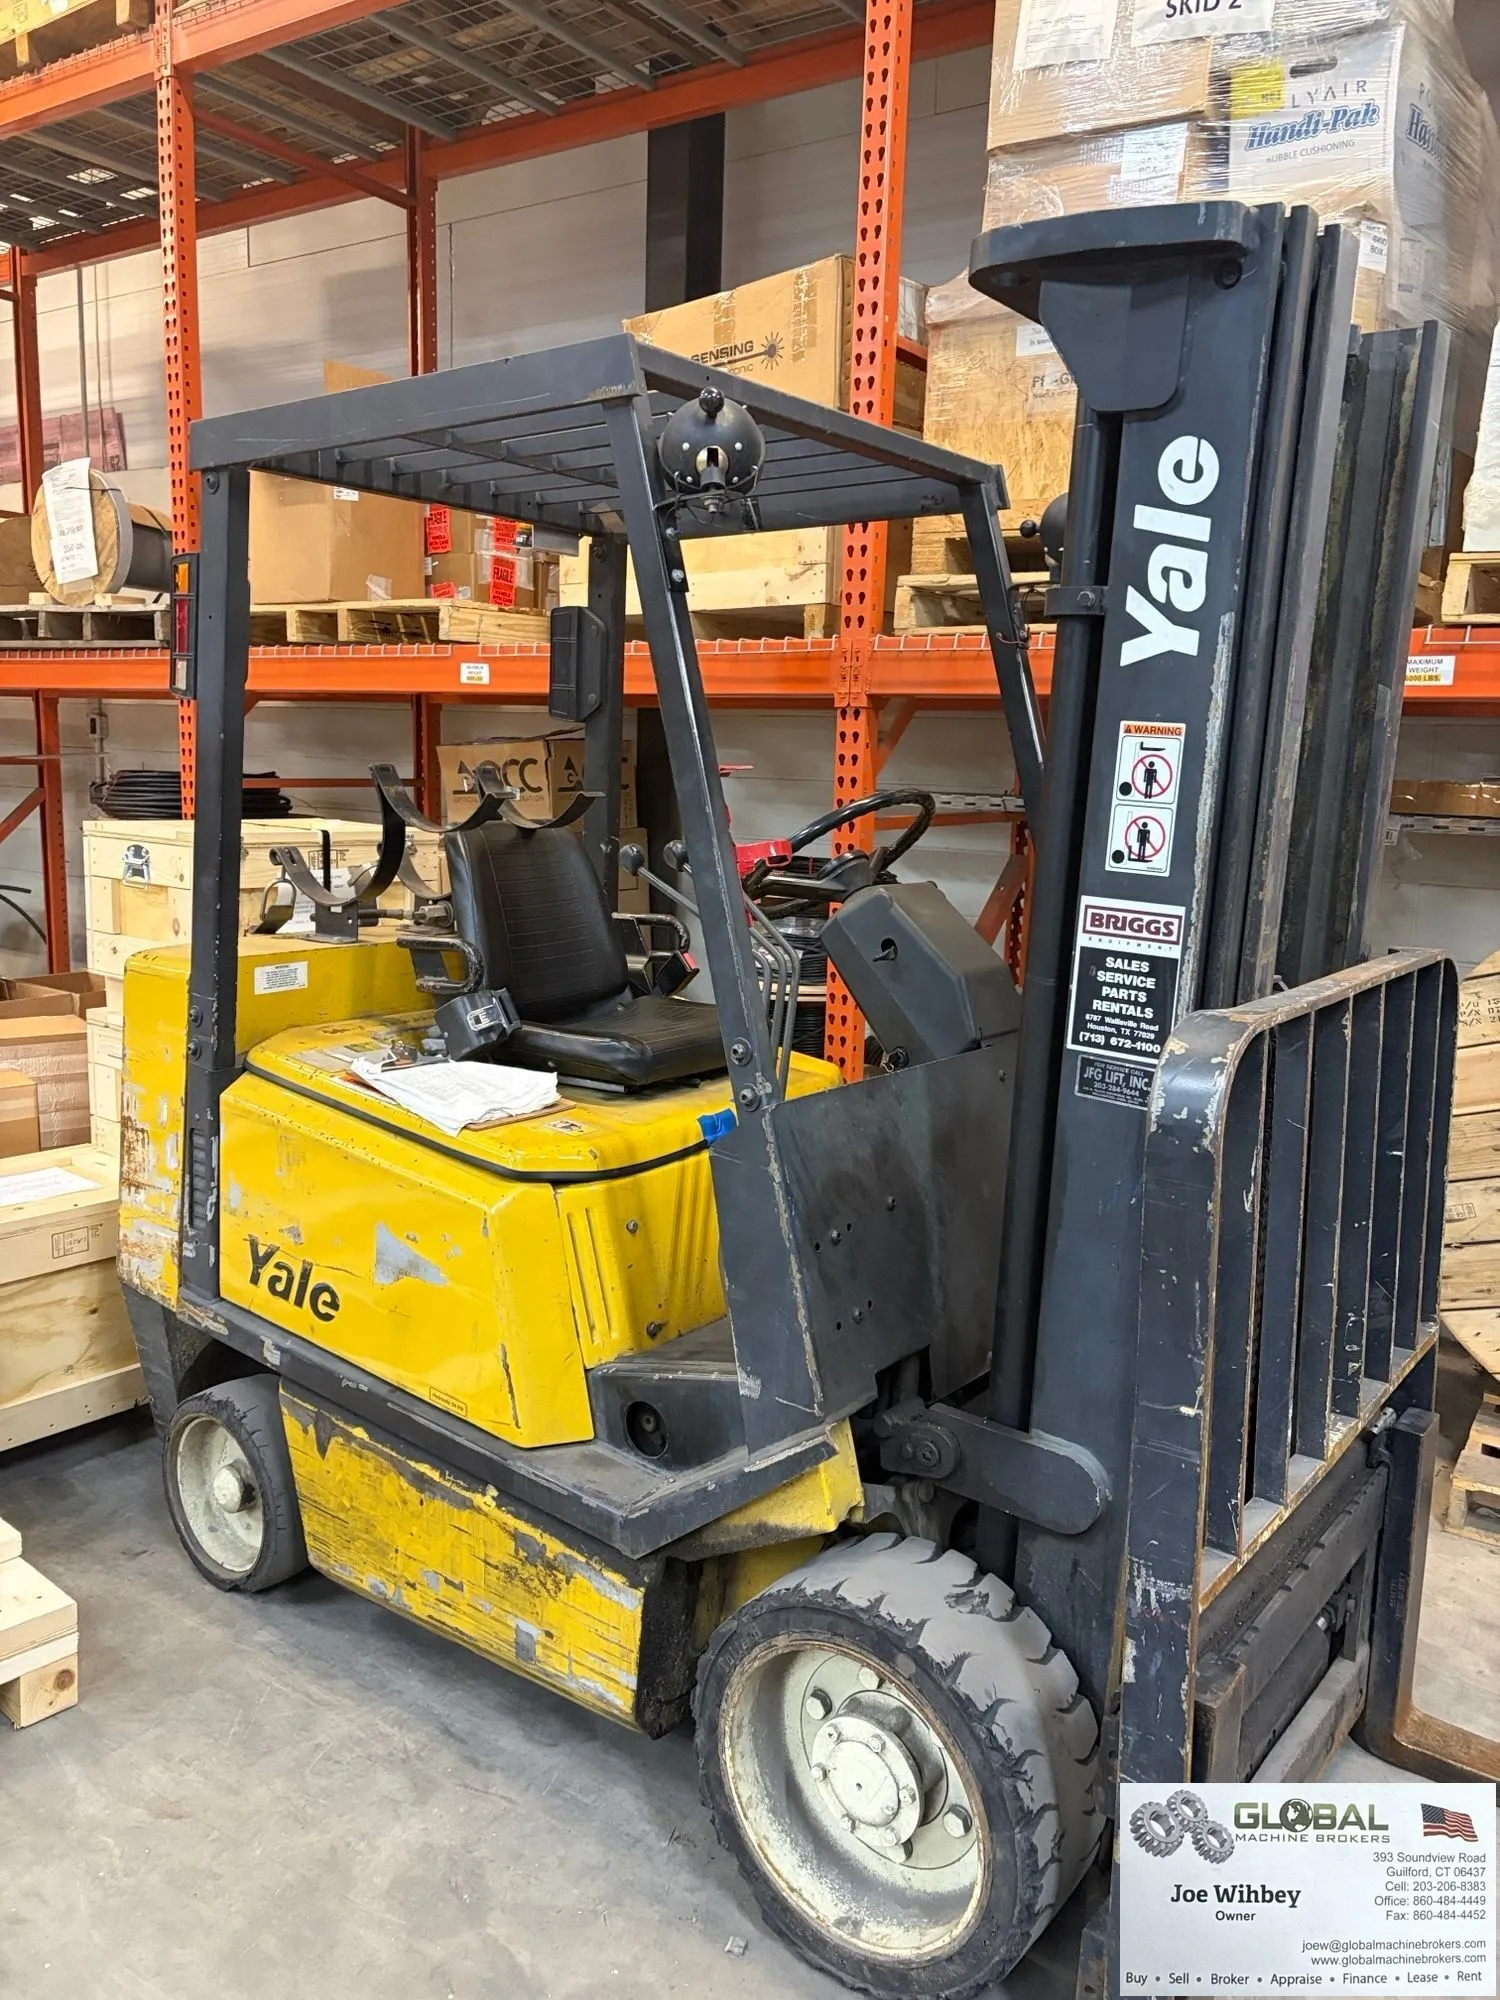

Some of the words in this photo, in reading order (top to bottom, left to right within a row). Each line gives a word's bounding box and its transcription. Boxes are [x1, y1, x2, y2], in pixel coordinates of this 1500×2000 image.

[1292, 80, 1367, 108] LYAIR
[1245, 99, 1380, 151] Handi-Pak
[1300, 139, 1355, 158] CUSHIONING
[690, 340, 754, 364] SENSING
[1120, 435, 1220, 667] Yale
[1134, 725, 1182, 736] WARNING
[1089, 912, 1175, 937] BRIGGS
[1105, 957, 1149, 973] SALES
[1096, 970, 1156, 989] SERVICE
[1102, 986, 1148, 1003] PARTS
[1092, 999, 1154, 1019] RENTALS
[1087, 1023, 1118, 1035] Houston,
[1121, 1028, 1131, 1036] TX
[1133, 1030, 1155, 1040] 77029
[1105, 1016, 1138, 1028] Wallisville
[1140, 1022, 1159, 1032] Road
[1079, 1031, 1105, 1046] (713)
[1110, 1037, 1161, 1054] 672-1100
[1083, 1066, 1102, 1080] JFG
[1105, 1070, 1126, 1087] LIFT,
[1129, 1076, 1151, 1091] INC.
[1094, 1082, 1139, 1097] 203-284-9644
[248, 1234, 340, 1322] Yale
